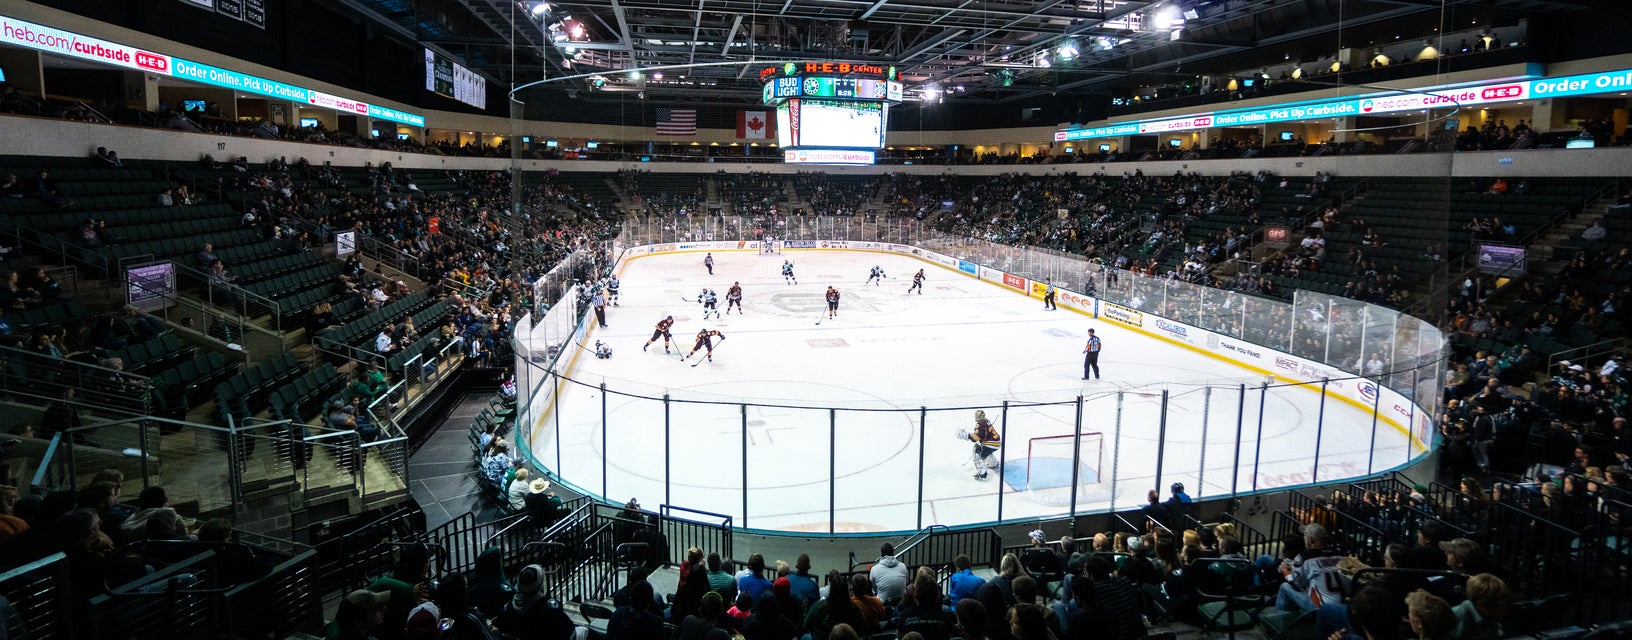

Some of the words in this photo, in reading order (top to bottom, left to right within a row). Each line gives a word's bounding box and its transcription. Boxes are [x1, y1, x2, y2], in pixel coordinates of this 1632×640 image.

[4, 21, 131, 63] heb.com/curbside
[853, 65, 883, 75] CENTER
[176, 62, 207, 79] Order
[209, 70, 242, 87] Online.
[244, 77, 261, 91] Pick
[262, 82, 274, 94] Up
[274, 85, 306, 100] Curbside.
[780, 77, 798, 88] BUD
[1534, 75, 1588, 94] Order
[777, 87, 799, 97] LIGHT
[370, 106, 382, 116] Order
[1216, 115, 1239, 124] Order
[1239, 112, 1268, 122] Online.
[1269, 109, 1288, 120] Pick
[1290, 107, 1305, 119] Up
[1306, 103, 1355, 116] Curbside.
[1095, 128, 1105, 136] Pick
[1106, 127, 1113, 136] Up
[217, 142, 226, 150] 117
[1155, 319, 1187, 334] EXCALIBUR
[1221, 341, 1236, 352] THANK
[1236, 345, 1246, 355] YOU
[1275, 357, 1299, 371] IMPACT
